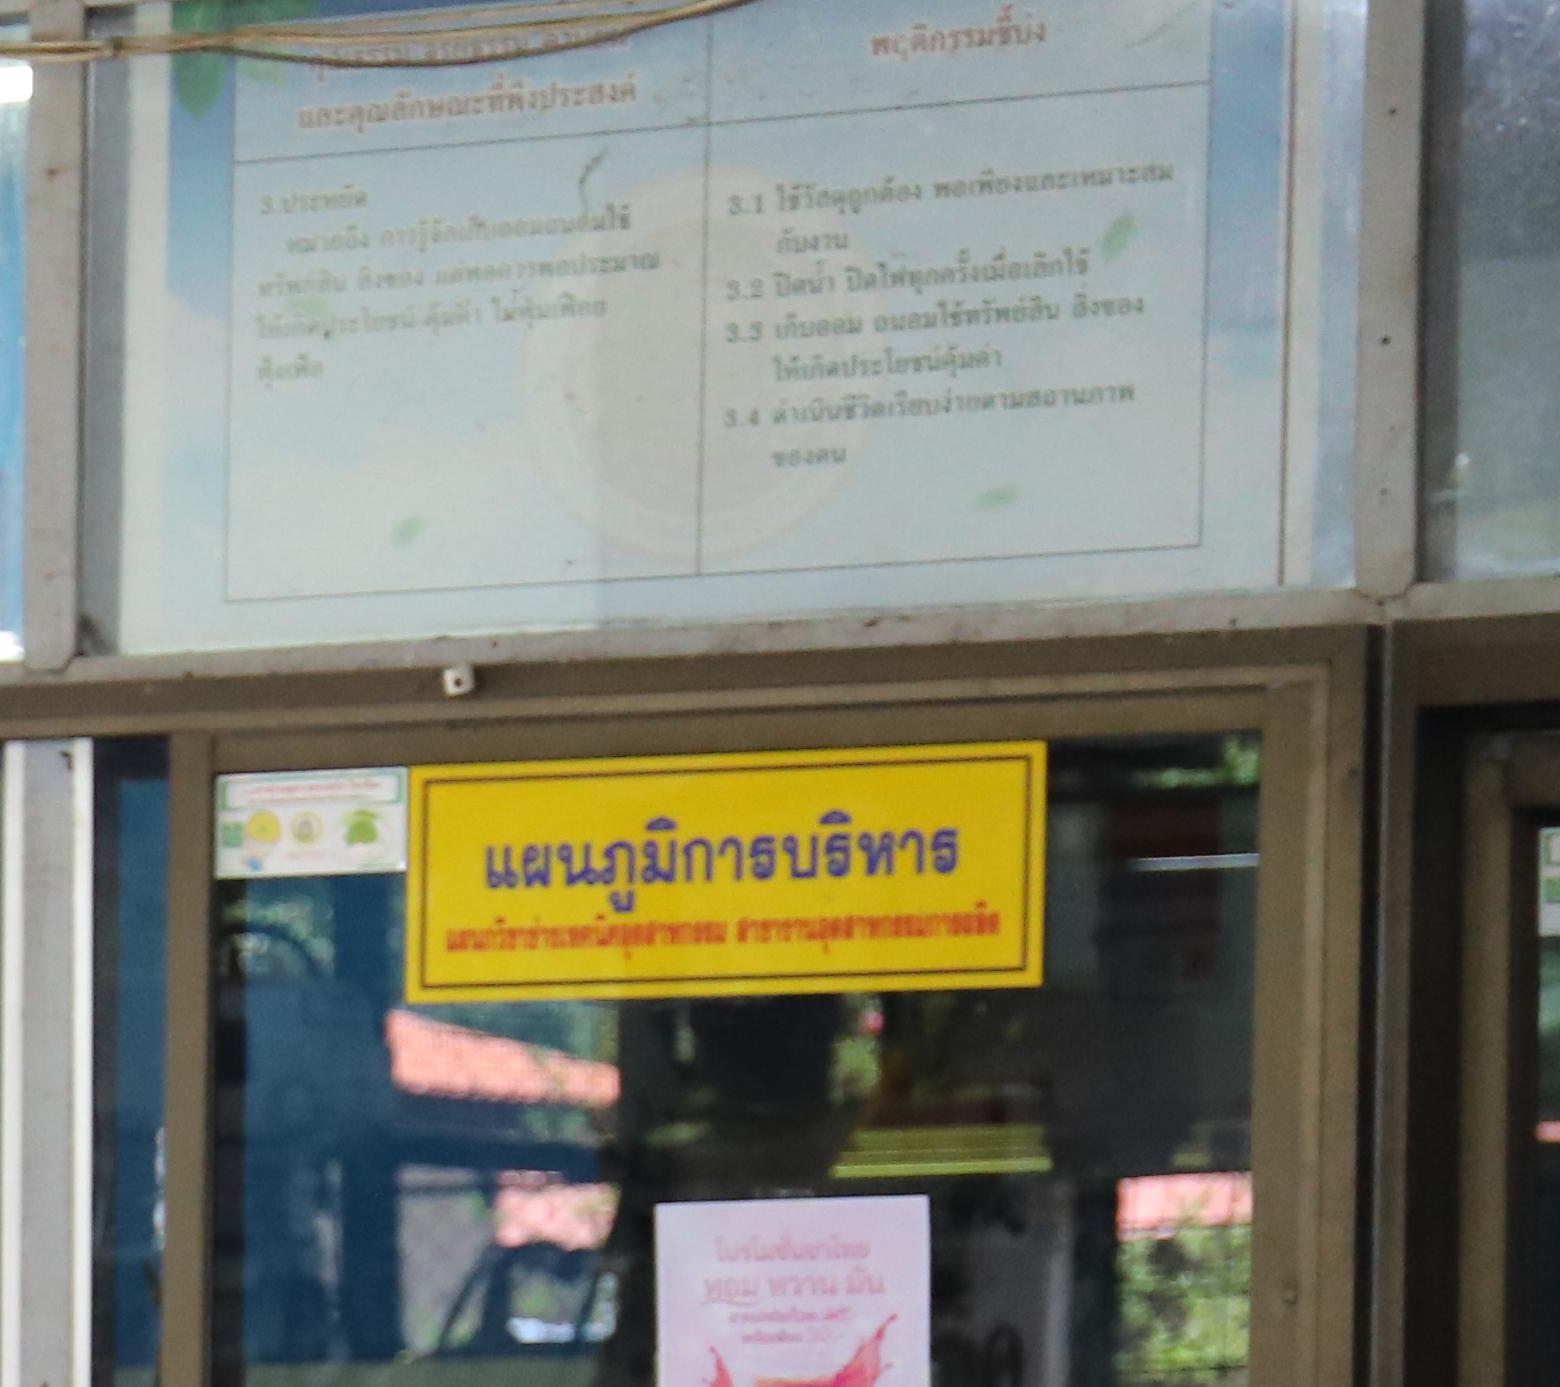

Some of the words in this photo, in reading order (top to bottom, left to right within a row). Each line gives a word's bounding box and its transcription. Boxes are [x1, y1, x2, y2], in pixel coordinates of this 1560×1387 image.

[484, 810, 959, 914] แผนภูมิการบริหาร
